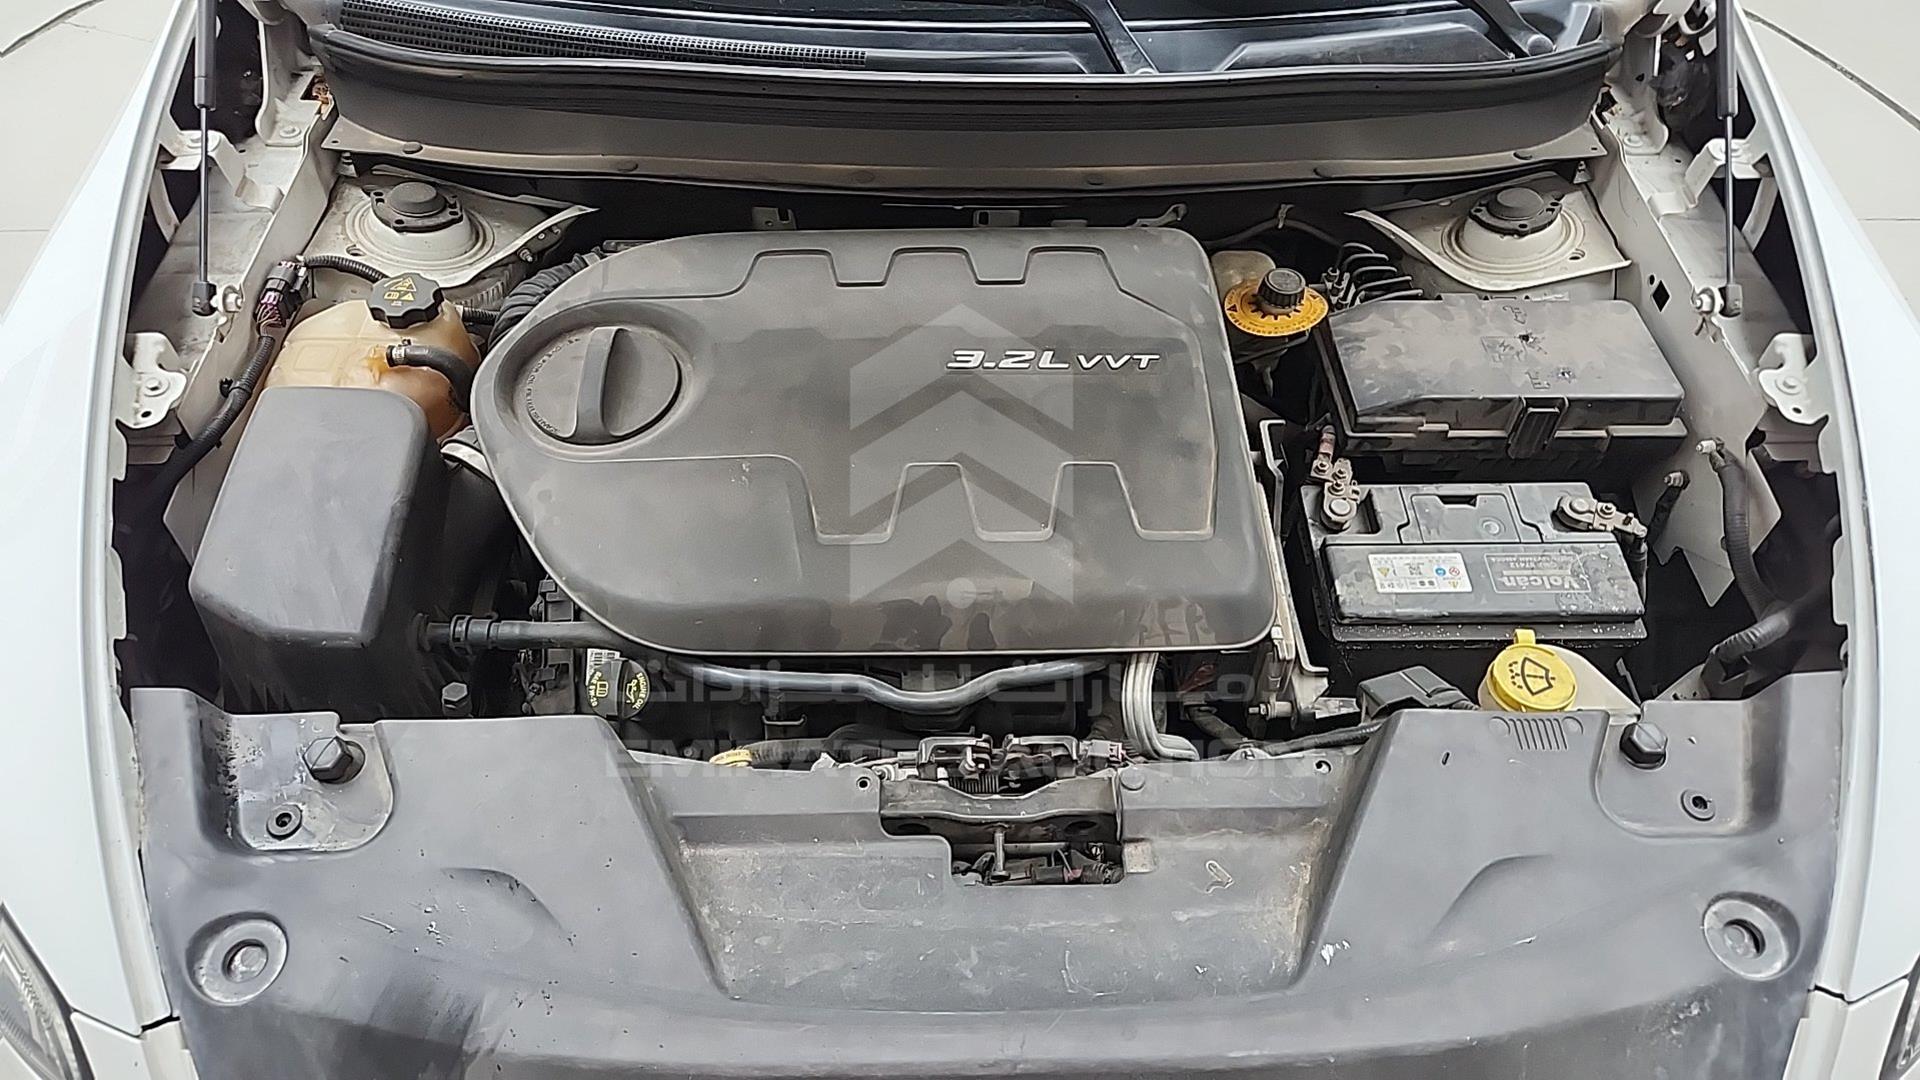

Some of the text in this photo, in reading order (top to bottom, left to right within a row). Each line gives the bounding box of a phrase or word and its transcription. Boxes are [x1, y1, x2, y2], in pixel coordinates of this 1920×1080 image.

[946, 350, 1161, 369] 3.2L VVT
[1499, 575, 1580, 590] Volcán
[632, 672, 647, 710] ENGINE OIL
